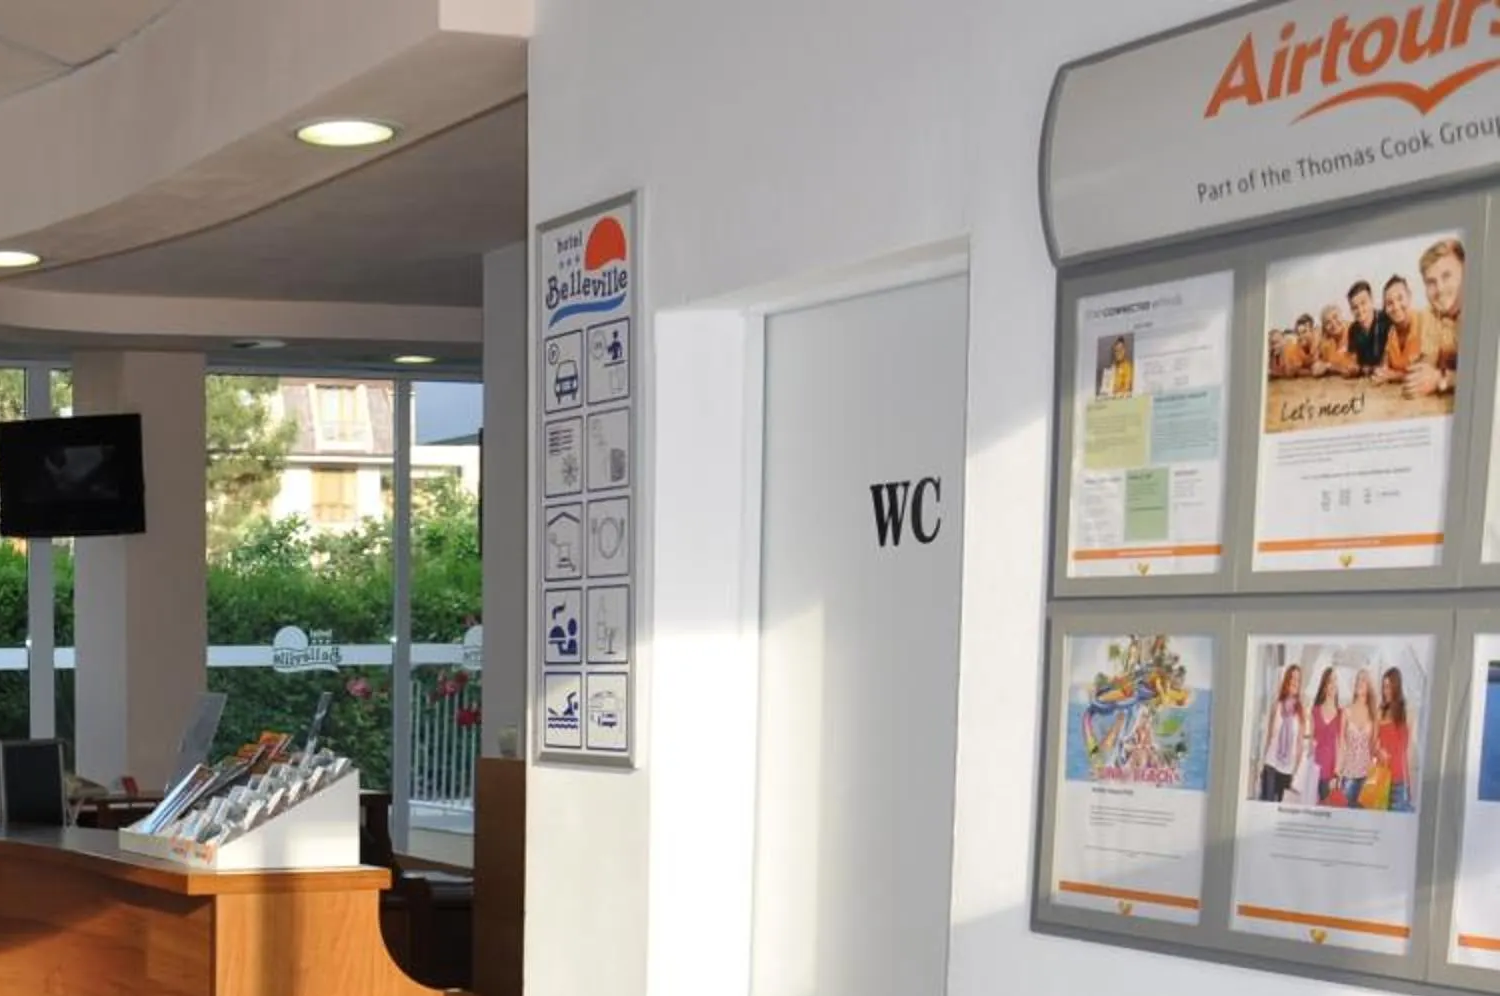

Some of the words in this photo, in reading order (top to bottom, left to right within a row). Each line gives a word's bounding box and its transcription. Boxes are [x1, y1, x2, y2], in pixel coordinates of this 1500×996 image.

[1197, 180, 1232, 204] Part
[1237, 170, 1256, 194] of
[1261, 164, 1292, 189] the
[1296, 145, 1376, 178] Thomas
[1380, 129, 1435, 160] Cook
[545, 265, 628, 310] Belleville
[869, 476, 942, 547] WC
